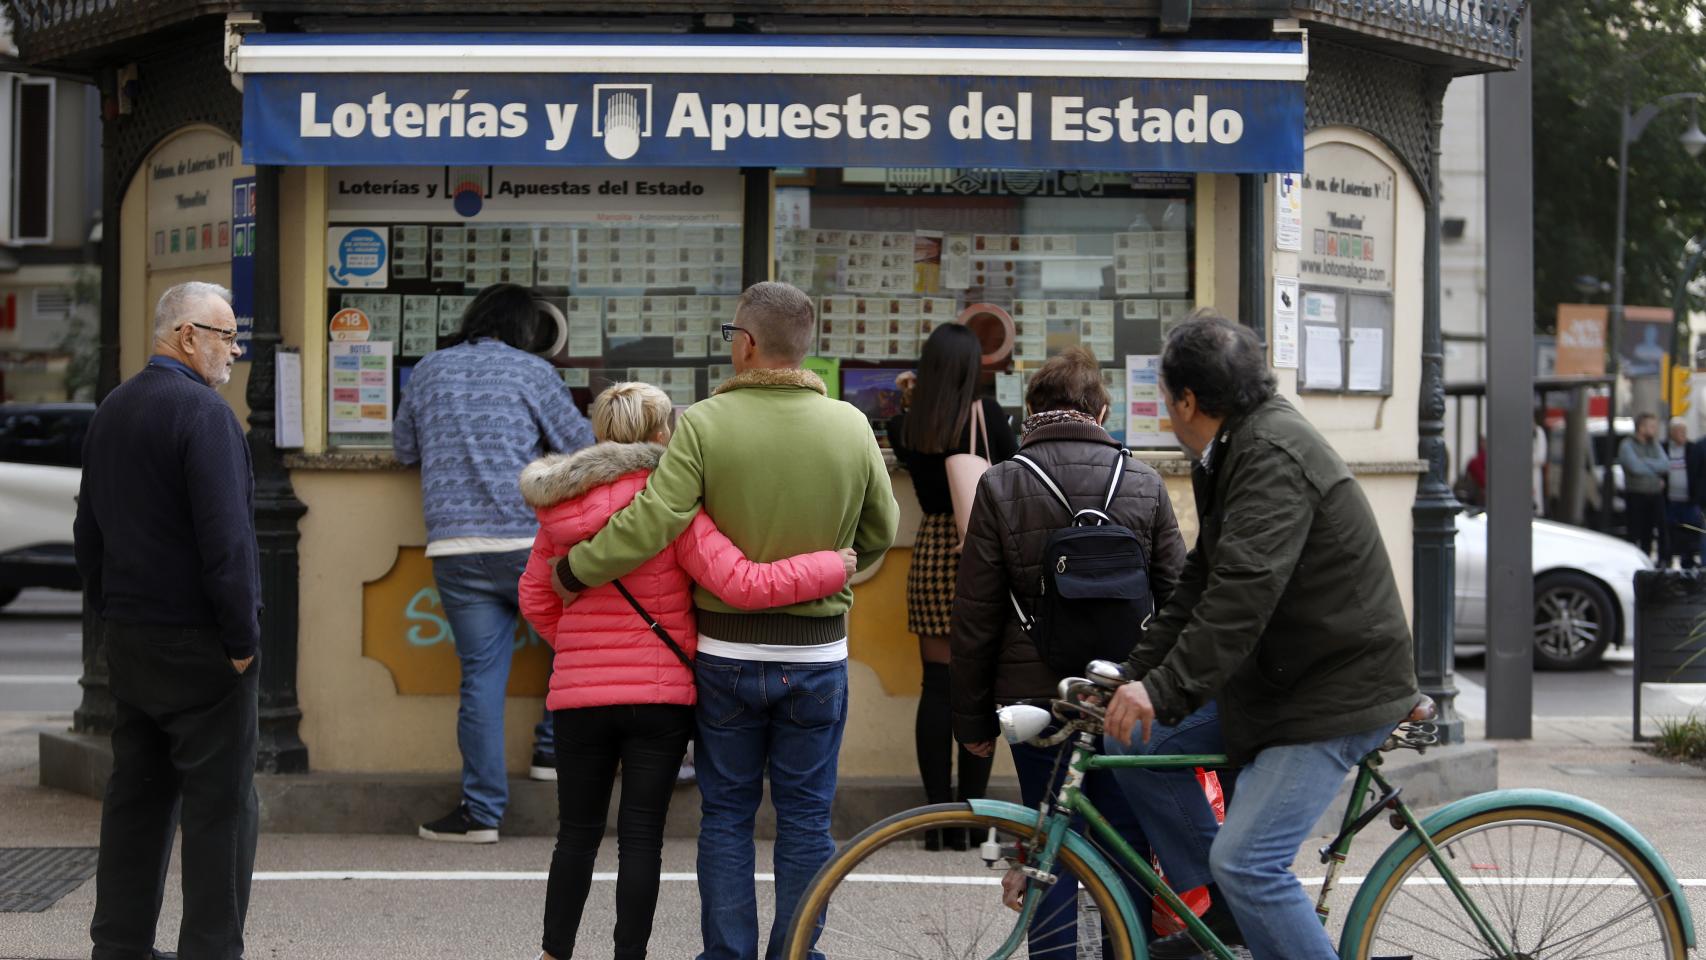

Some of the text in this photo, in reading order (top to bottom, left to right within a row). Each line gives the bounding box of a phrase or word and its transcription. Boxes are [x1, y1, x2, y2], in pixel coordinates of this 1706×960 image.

[300, 90, 1244, 151] Loterías y Apuestas del Estado
[338, 179, 705, 198] Loterías y Apuestas del Estado
[1329, 177, 1340, 193] de
[349, 344, 372, 354] BOTES
